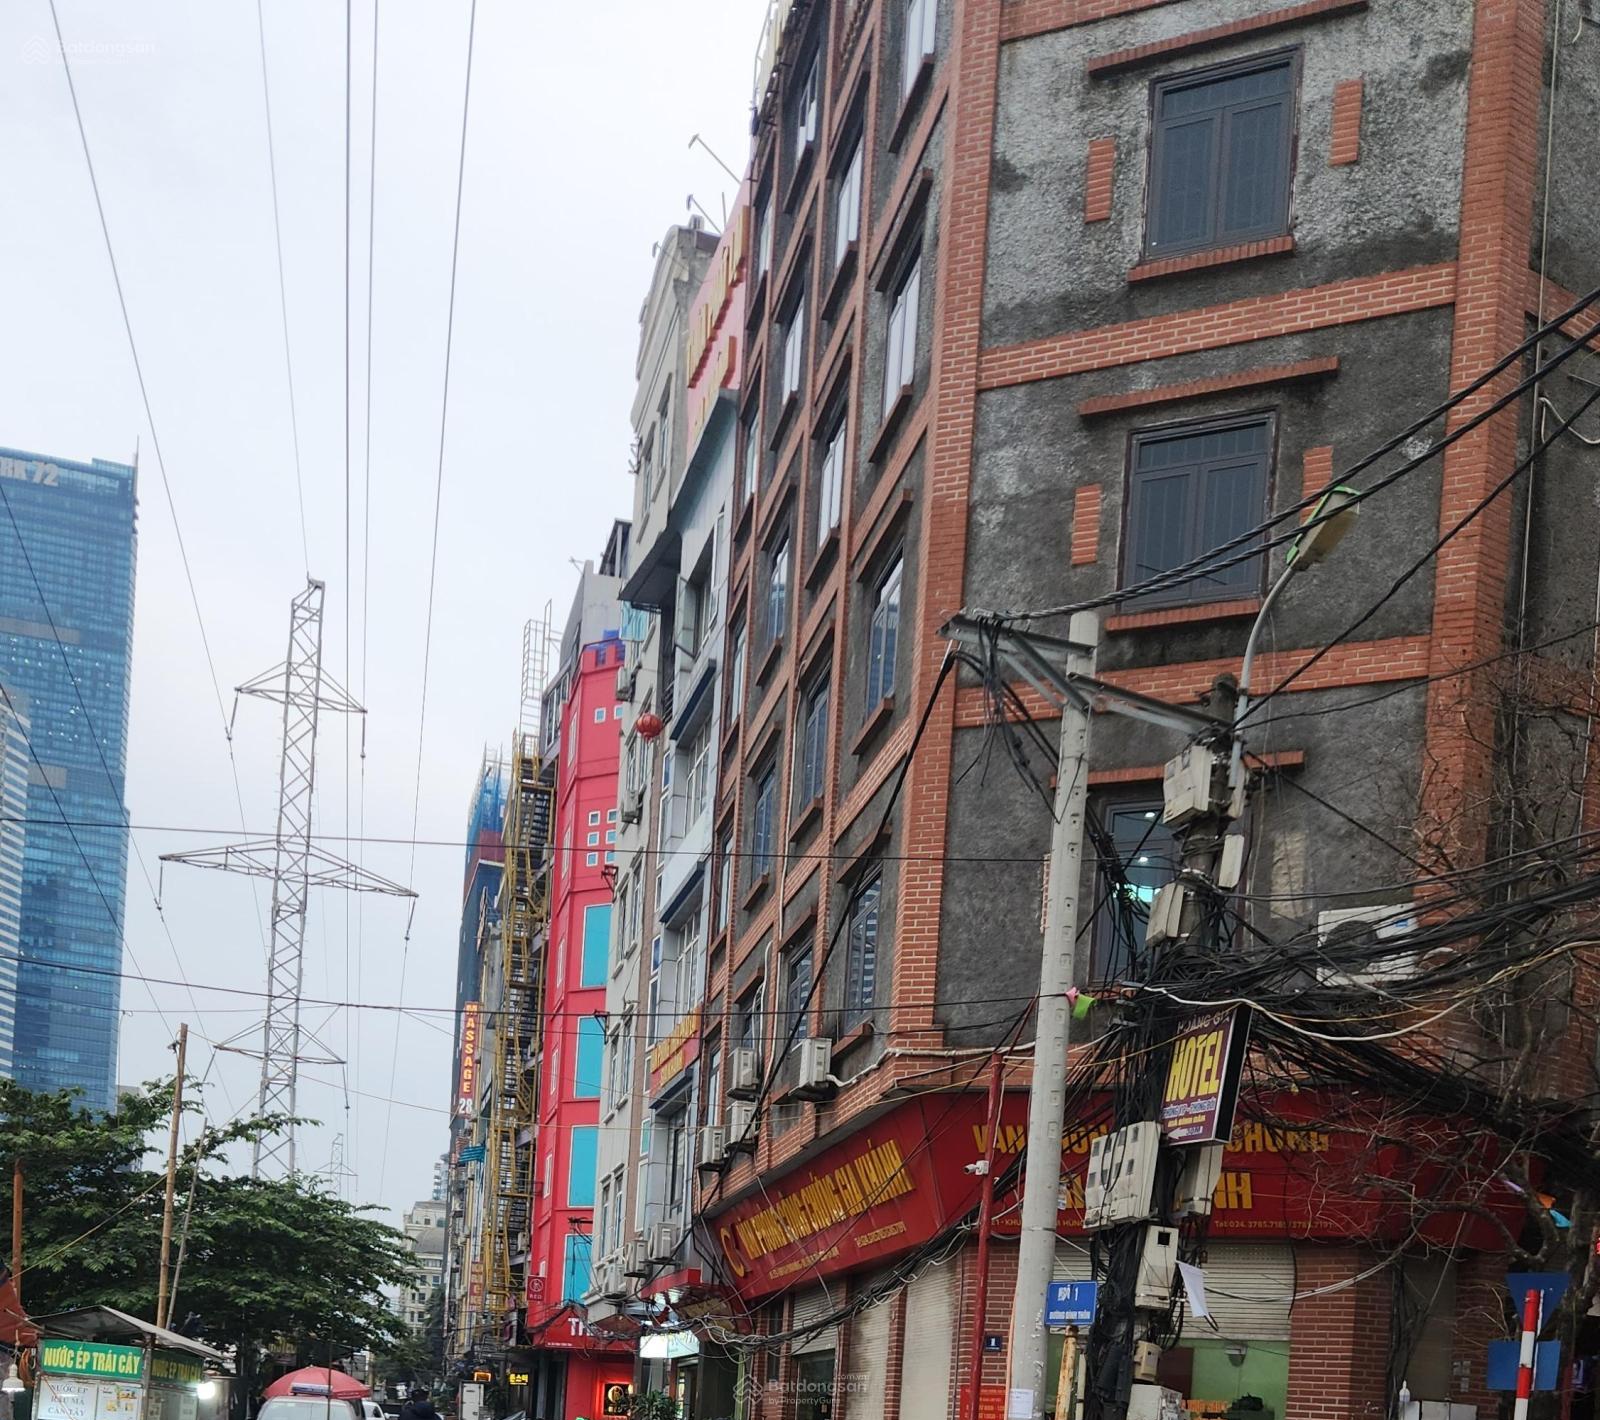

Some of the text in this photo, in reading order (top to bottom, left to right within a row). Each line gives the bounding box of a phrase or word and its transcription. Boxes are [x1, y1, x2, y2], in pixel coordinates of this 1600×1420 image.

[32, 460, 58, 487] 72
[463, 1003, 478, 1092] MASSAGE
[1166, 1030, 1224, 1102] HOTEL
[459, 1098, 473, 1114] 28
[991, 1338, 996, 1346] 1
[44, 1345, 141, 1375] NƯỚC ÉP TRÁI CÂY
